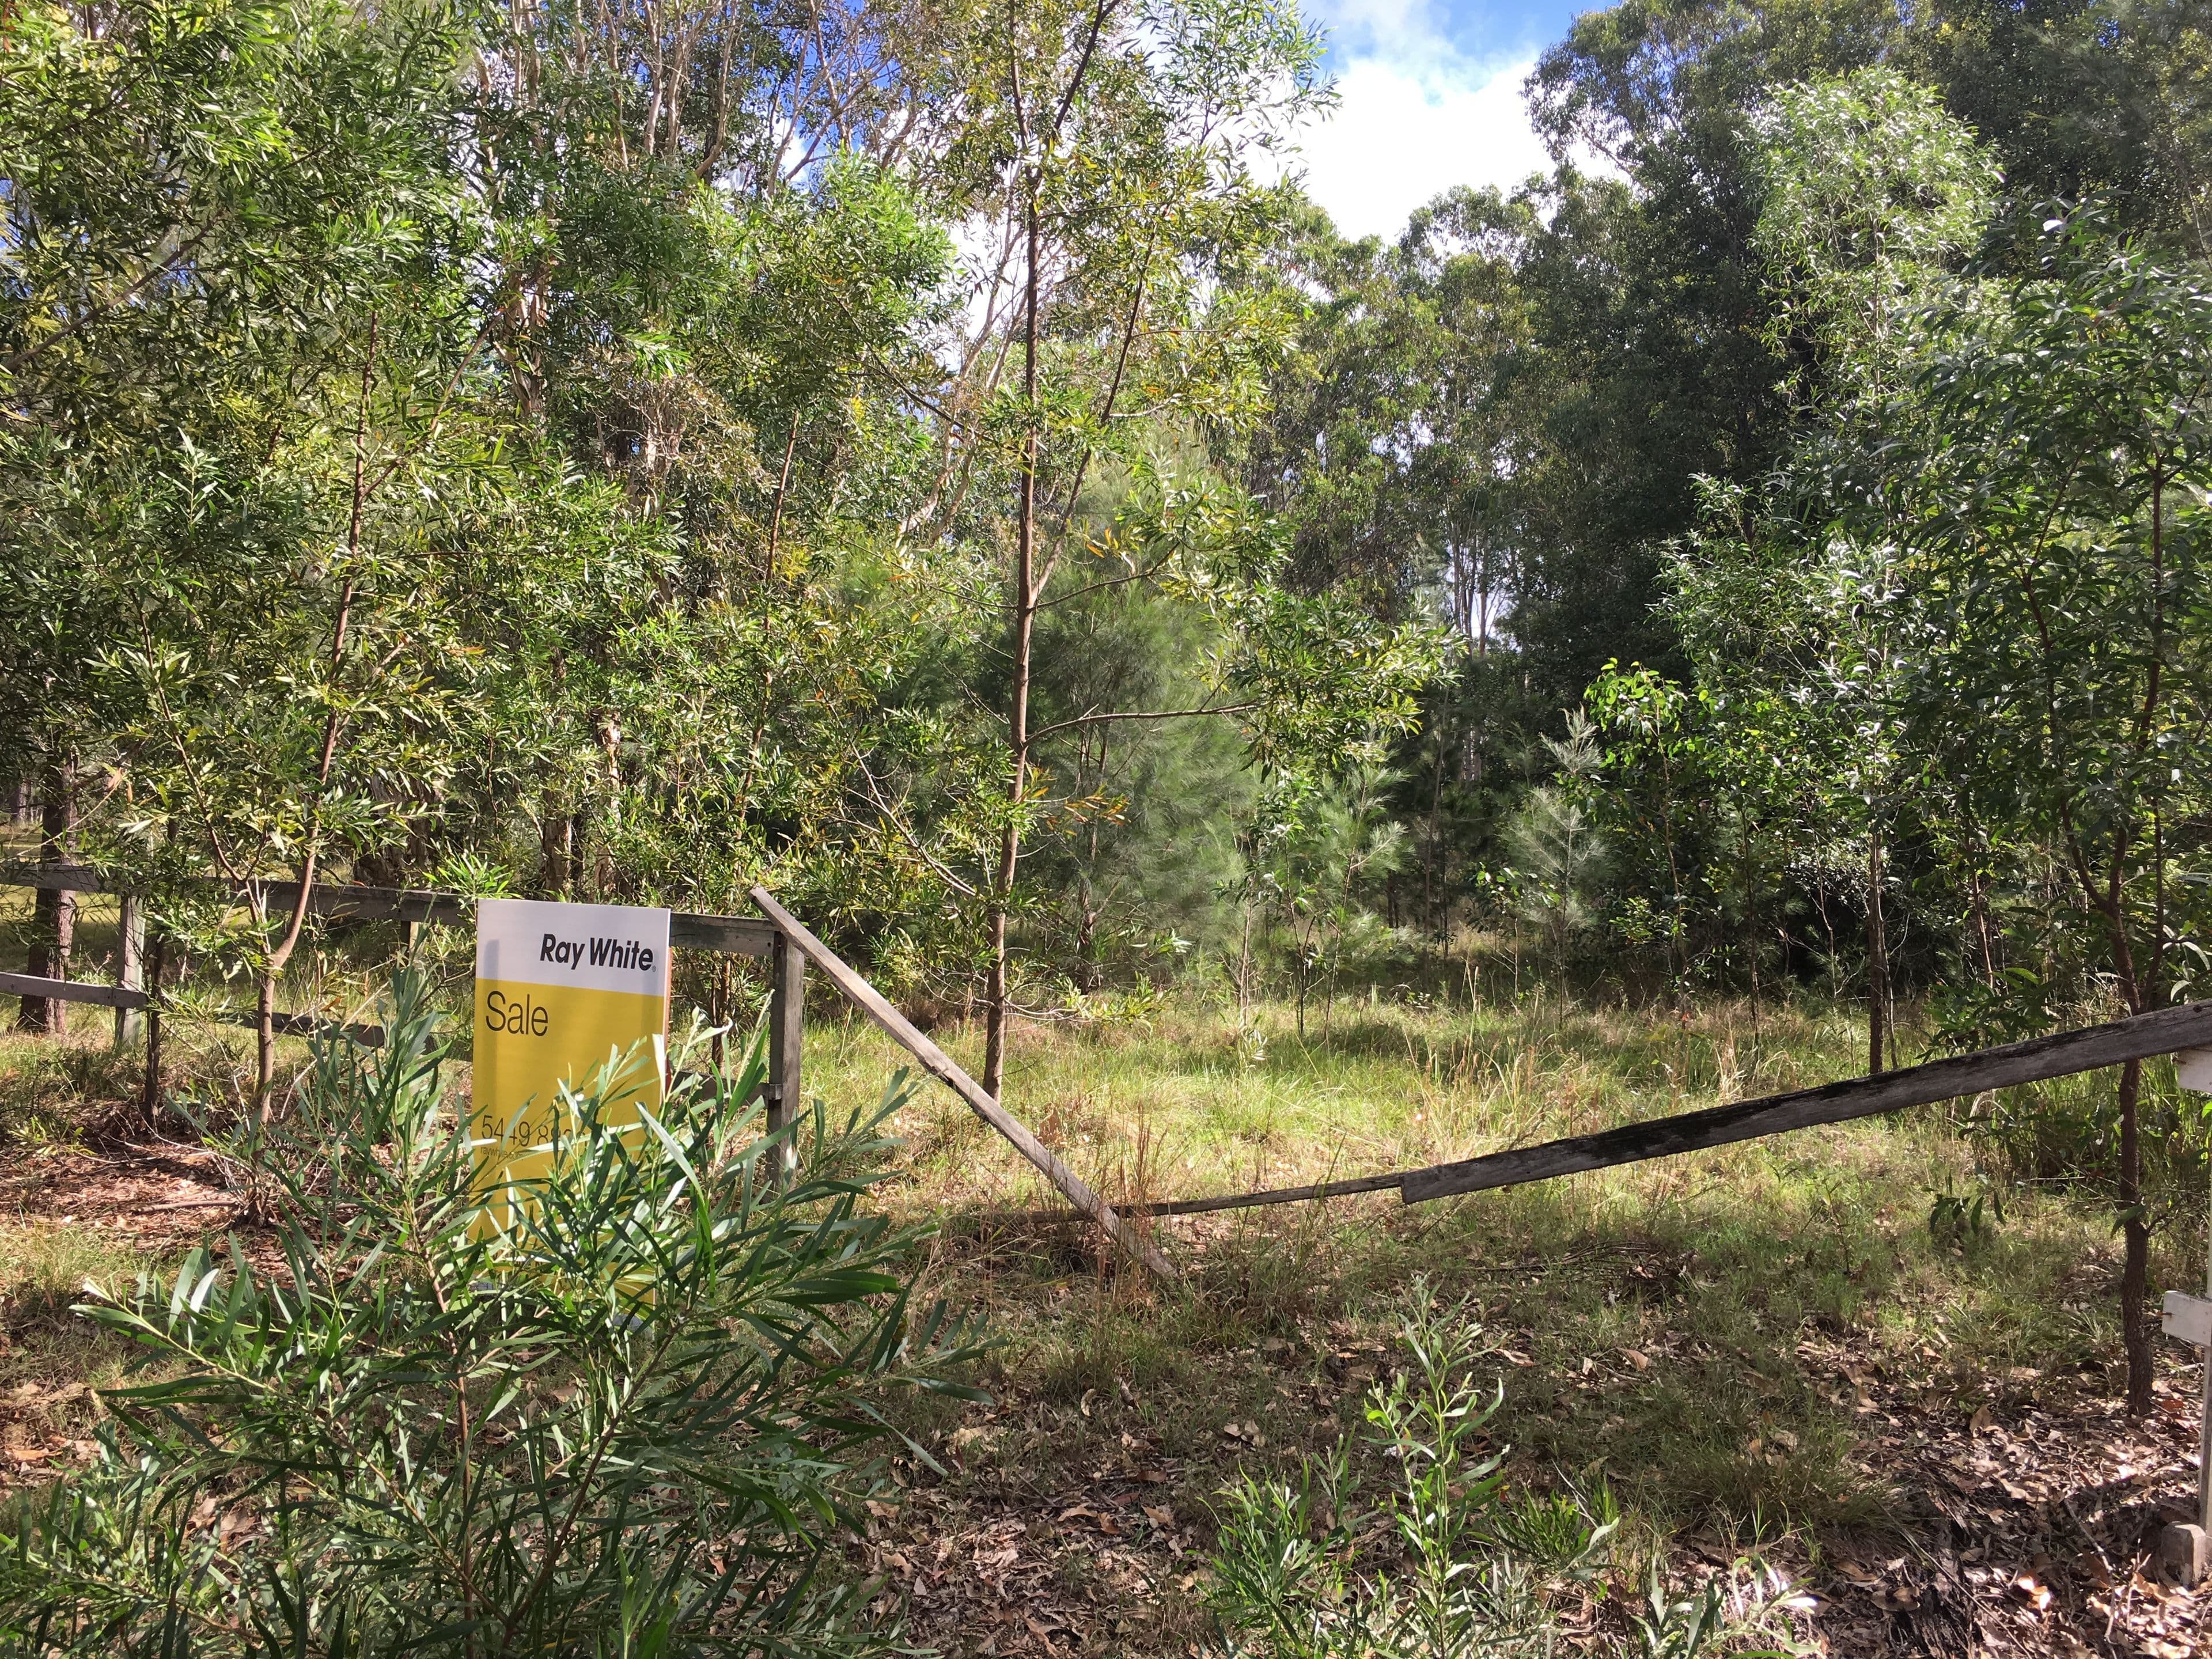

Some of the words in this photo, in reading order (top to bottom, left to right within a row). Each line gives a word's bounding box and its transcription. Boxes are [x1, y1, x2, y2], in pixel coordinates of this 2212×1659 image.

[540, 933, 585, 969] Ray
[589, 937, 654, 971] White
[486, 990, 548, 1036] Sale
